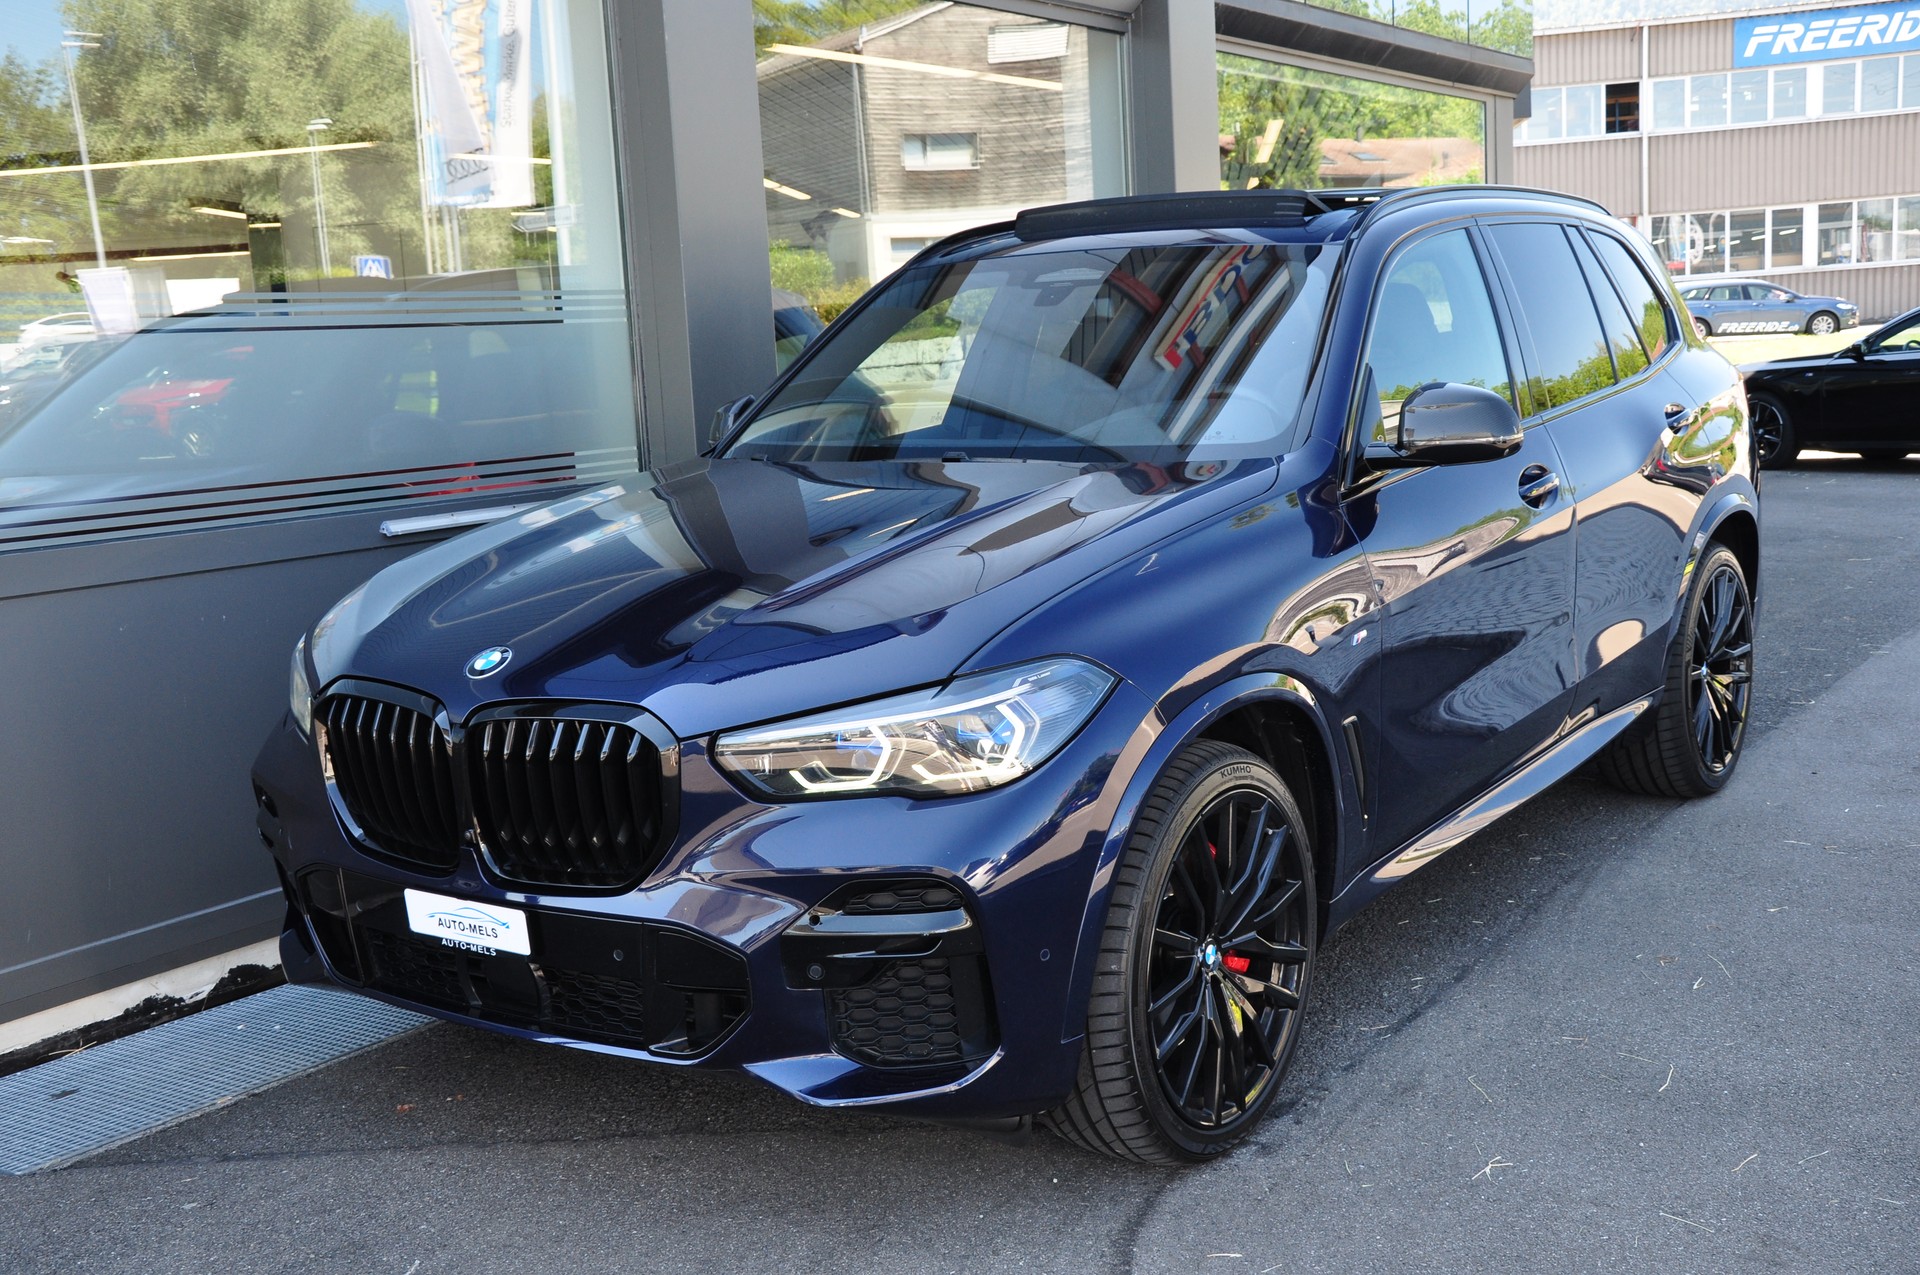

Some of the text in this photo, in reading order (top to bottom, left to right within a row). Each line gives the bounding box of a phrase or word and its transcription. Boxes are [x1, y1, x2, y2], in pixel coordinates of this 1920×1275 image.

[1743, 9, 1920, 58] FREERID
[1220, 765, 1252, 779] KUMHO
[438, 917, 498, 939] AUTO-MELS
[441, 938, 497, 956] AUTO-MELS
